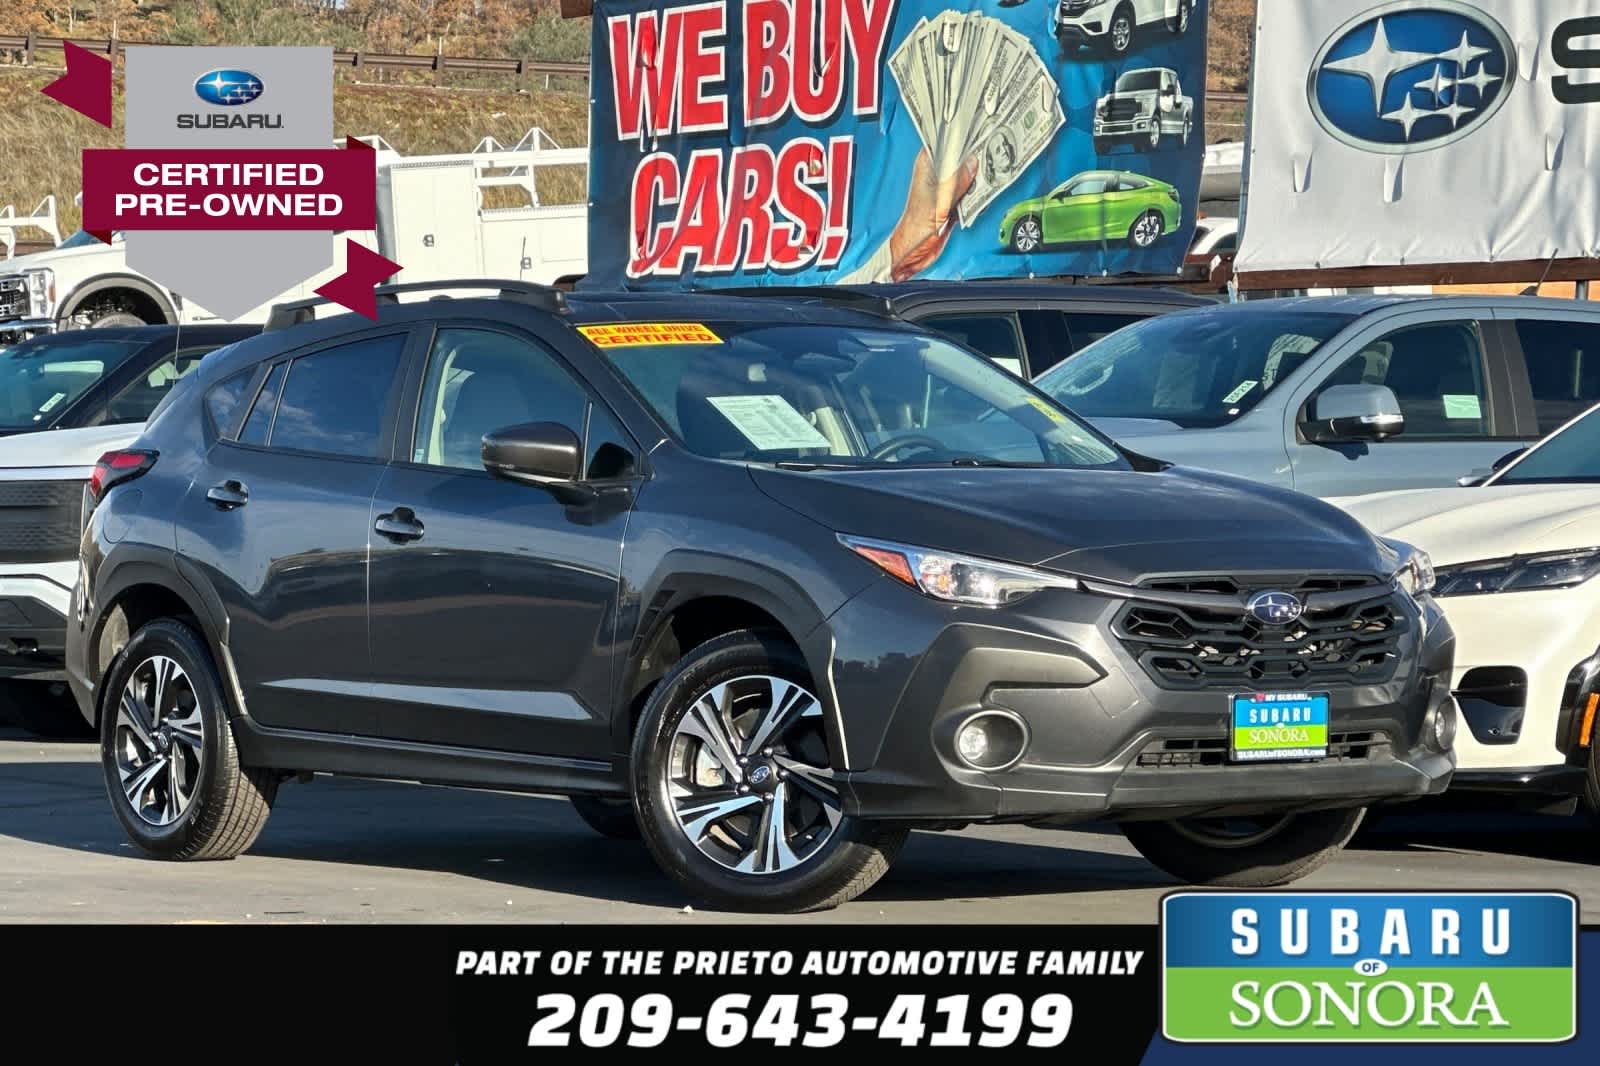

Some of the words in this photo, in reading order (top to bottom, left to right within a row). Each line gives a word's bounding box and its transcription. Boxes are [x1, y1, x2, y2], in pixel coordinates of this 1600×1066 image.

[606, 0, 729, 141] WE
[743, 0, 893, 127] BUY
[626, 135, 854, 280] CARS!
[586, 328, 611, 336] ALL
[616, 326, 658, 334] WHEEL
[663, 324, 701, 333] DRIVE
[592, 333, 713, 345] CERTIFIED
[1250, 708, 1311, 723] SUBARU
[1250, 728, 1309, 743] SONORA
